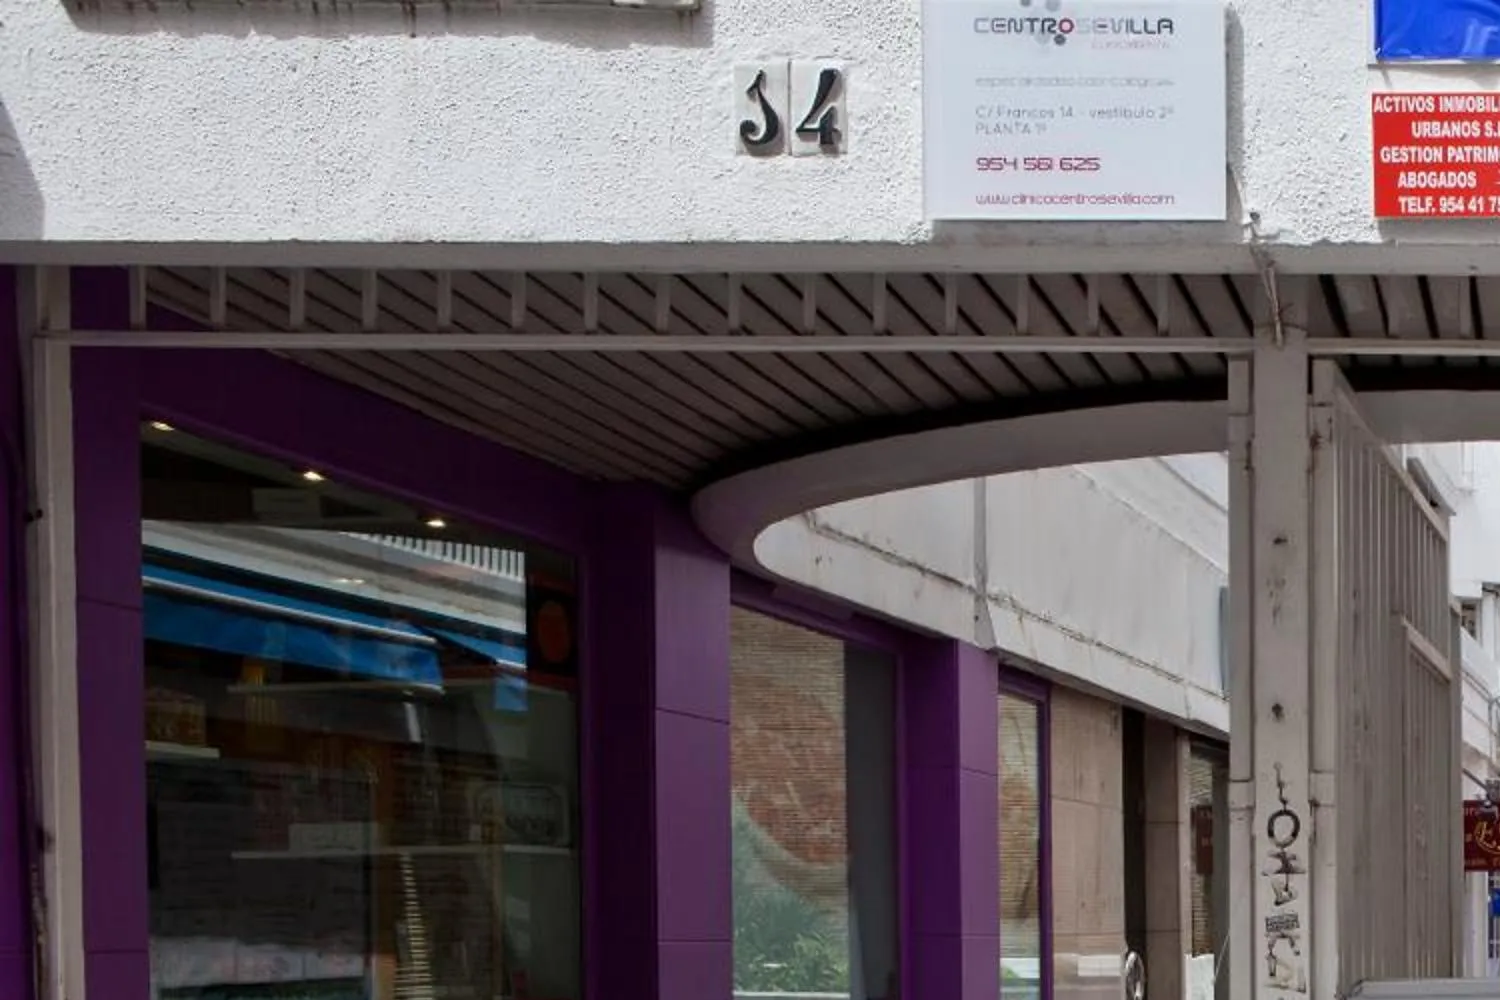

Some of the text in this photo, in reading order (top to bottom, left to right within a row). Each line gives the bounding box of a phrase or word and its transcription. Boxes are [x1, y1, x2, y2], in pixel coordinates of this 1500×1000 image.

[1373, 96, 1435, 113] ACTIVOS
[975, 122, 1031, 135] PLANTA
[1411, 120, 1480, 138] URBANOS
[1380, 146, 1442, 163] GESTION
[976, 157, 1018, 172] 954
[1059, 157, 1101, 172] 625
[1398, 171, 1477, 188] ABOGADOS
[1398, 196, 1436, 213] TELF.
[1439, 196, 1465, 213] 954
[1467, 196, 1484, 213] 41
